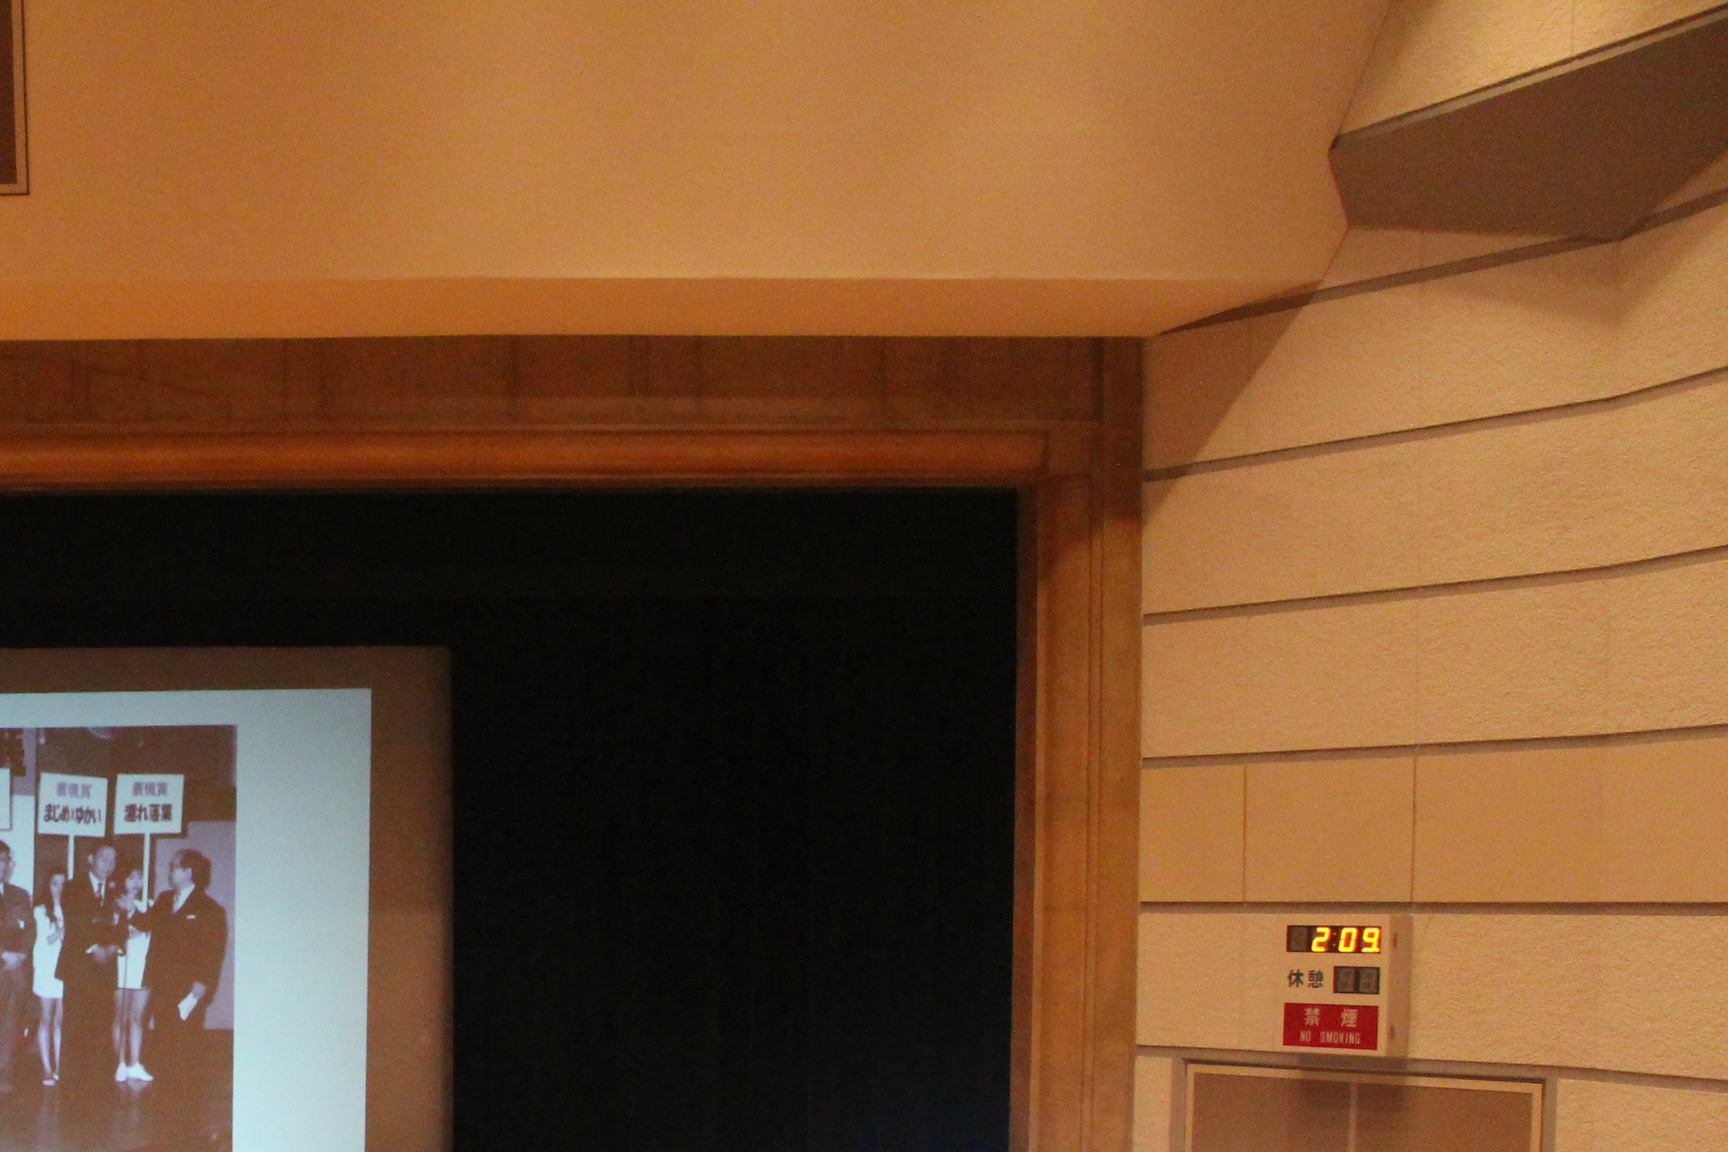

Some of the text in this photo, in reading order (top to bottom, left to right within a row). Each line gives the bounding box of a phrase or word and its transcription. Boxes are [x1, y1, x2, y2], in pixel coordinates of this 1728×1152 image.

[1287, 969, 1325, 989] 休憩
[1303, 1006, 1359, 1029] 禁煙
[1299, 1030, 1361, 1045] NO SMOKING
